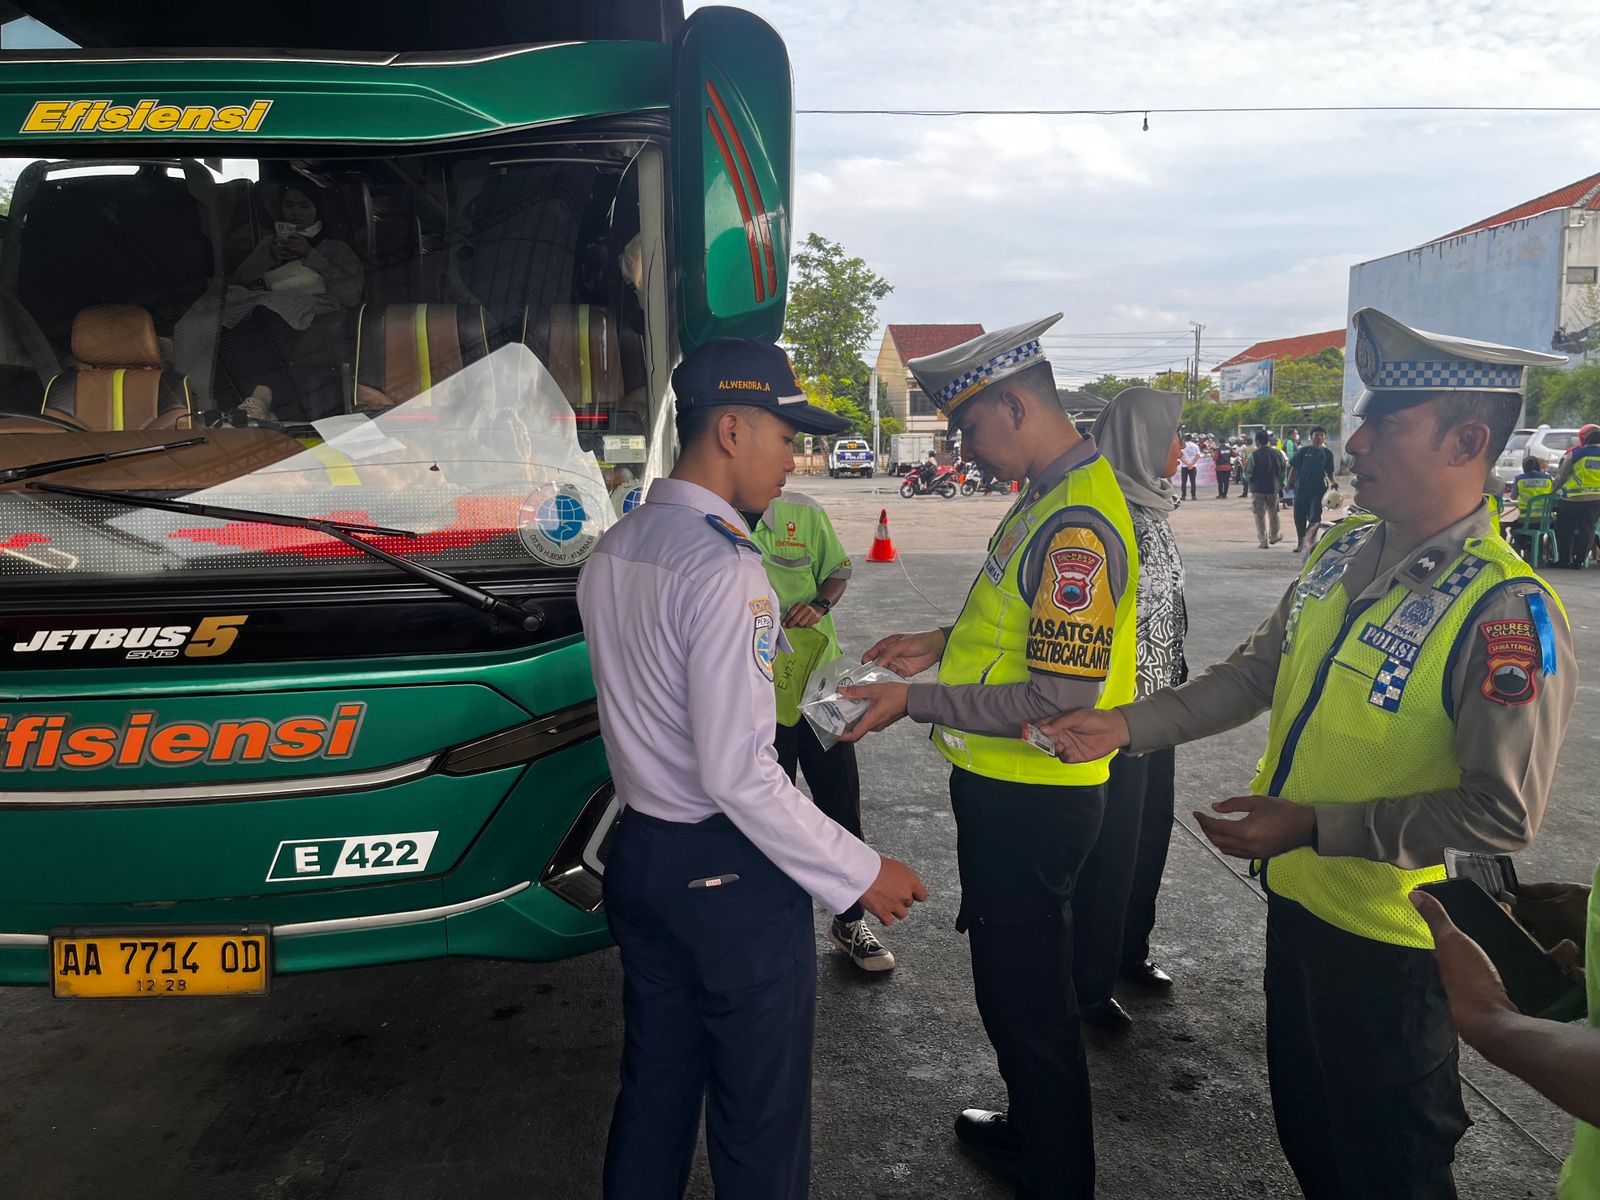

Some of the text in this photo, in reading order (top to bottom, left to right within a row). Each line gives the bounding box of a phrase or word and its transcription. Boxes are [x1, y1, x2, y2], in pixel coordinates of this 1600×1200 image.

[19, 99, 274, 133] Efisiensi
[13, 615, 249, 658] JETBUS 5
[1362, 626, 1418, 662] POLISI
[0, 701, 368, 772] fisiensi
[295, 839, 419, 873] E 422
[61, 943, 102, 976] AA
[119, 941, 200, 974] 7714
